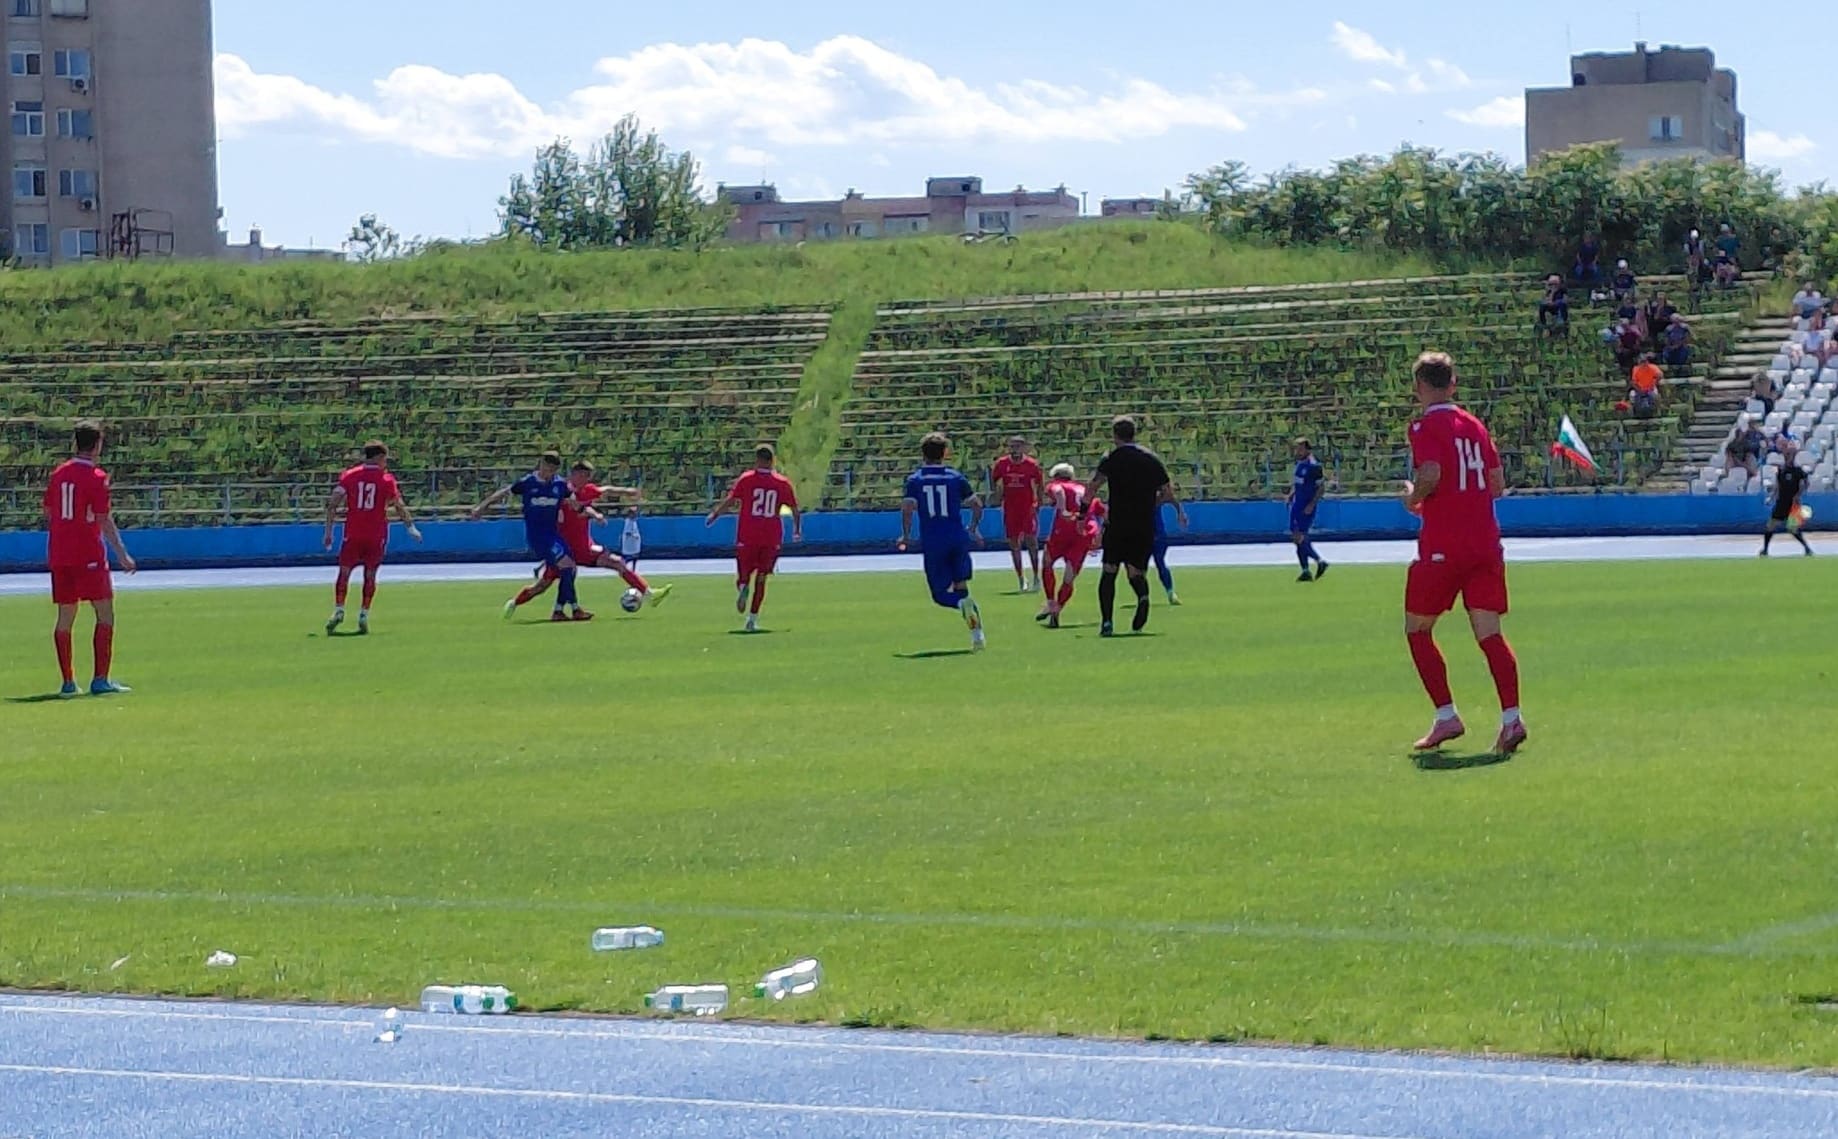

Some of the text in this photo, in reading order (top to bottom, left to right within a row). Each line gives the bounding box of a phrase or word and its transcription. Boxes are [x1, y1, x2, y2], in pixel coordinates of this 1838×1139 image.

[1455, 437, 1486, 491] 14
[61, 482, 75, 520] 11
[357, 481, 376, 510] 13
[752, 488, 777, 518] 20
[922, 485, 948, 518] 11
